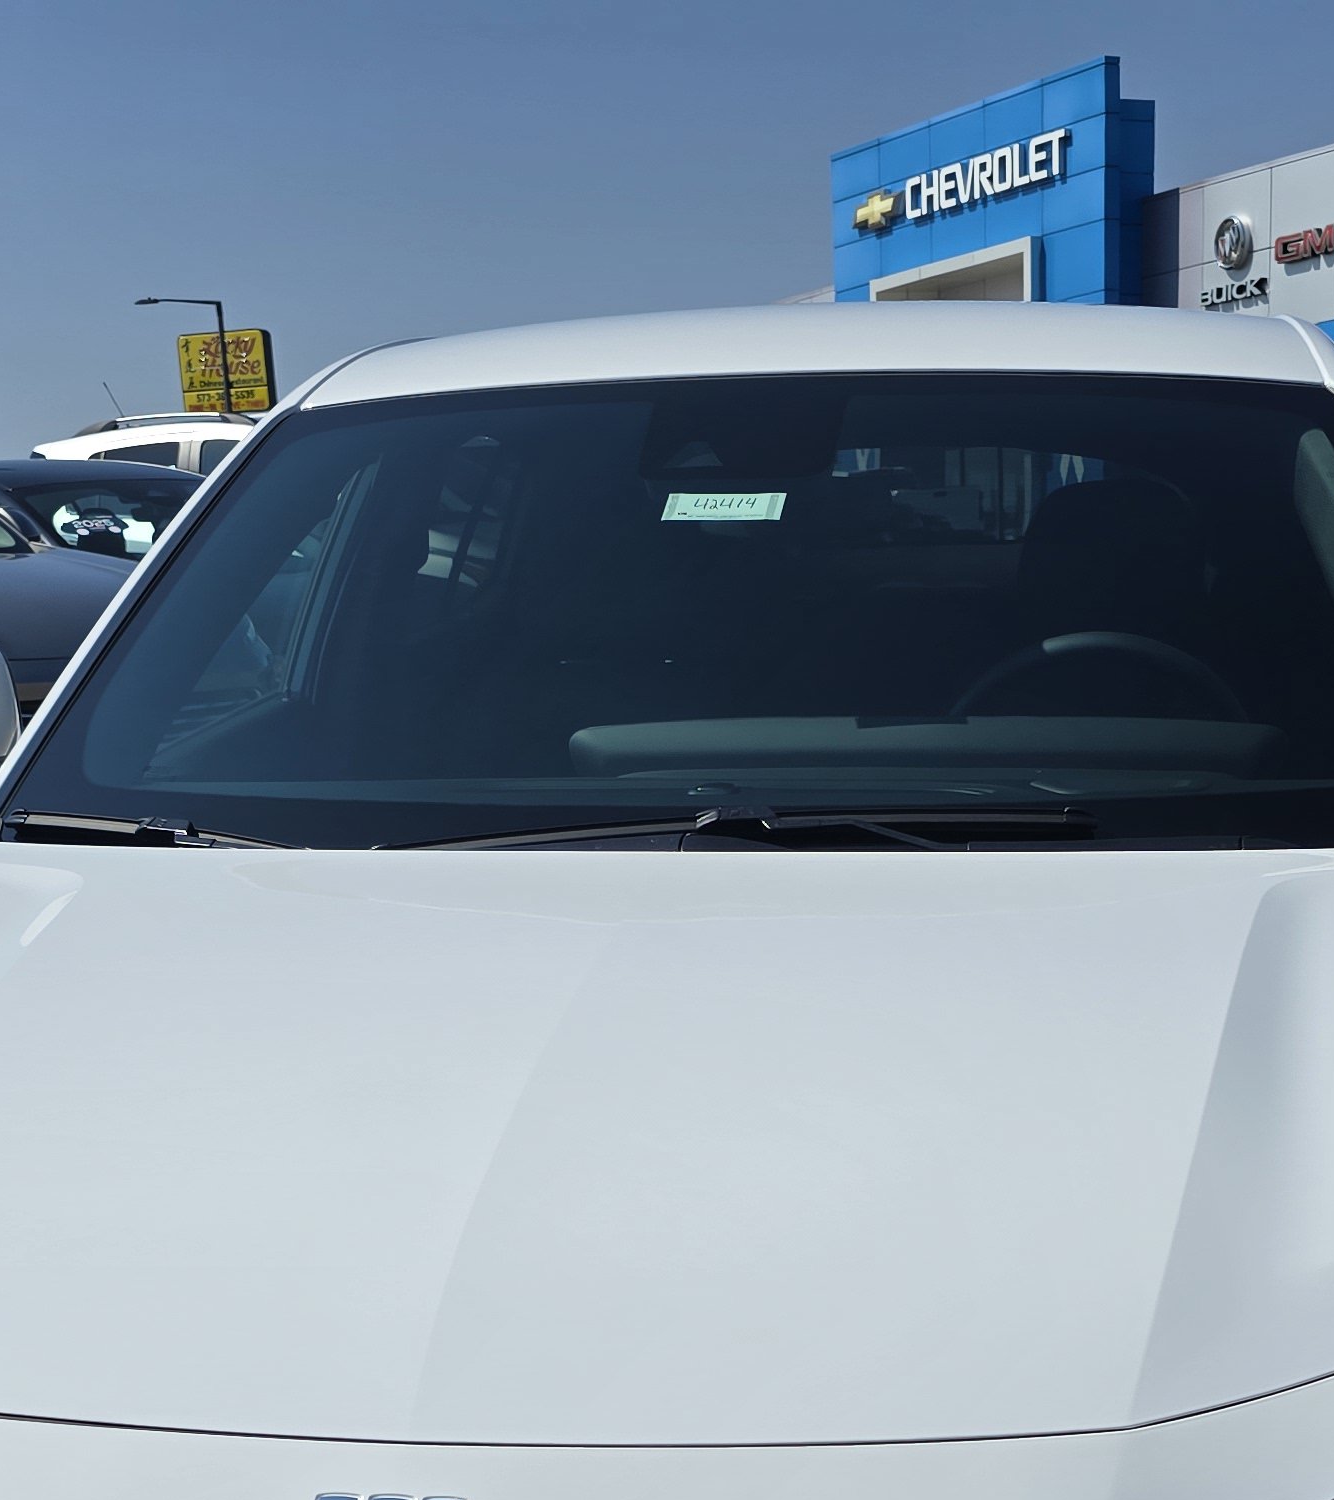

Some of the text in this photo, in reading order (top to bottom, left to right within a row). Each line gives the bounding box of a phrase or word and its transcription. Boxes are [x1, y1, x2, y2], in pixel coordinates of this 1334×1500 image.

[905, 128, 1066, 220] CHEVROLET
[1200, 278, 1262, 307] BUICK
[694, 497, 757, 510] 42414
